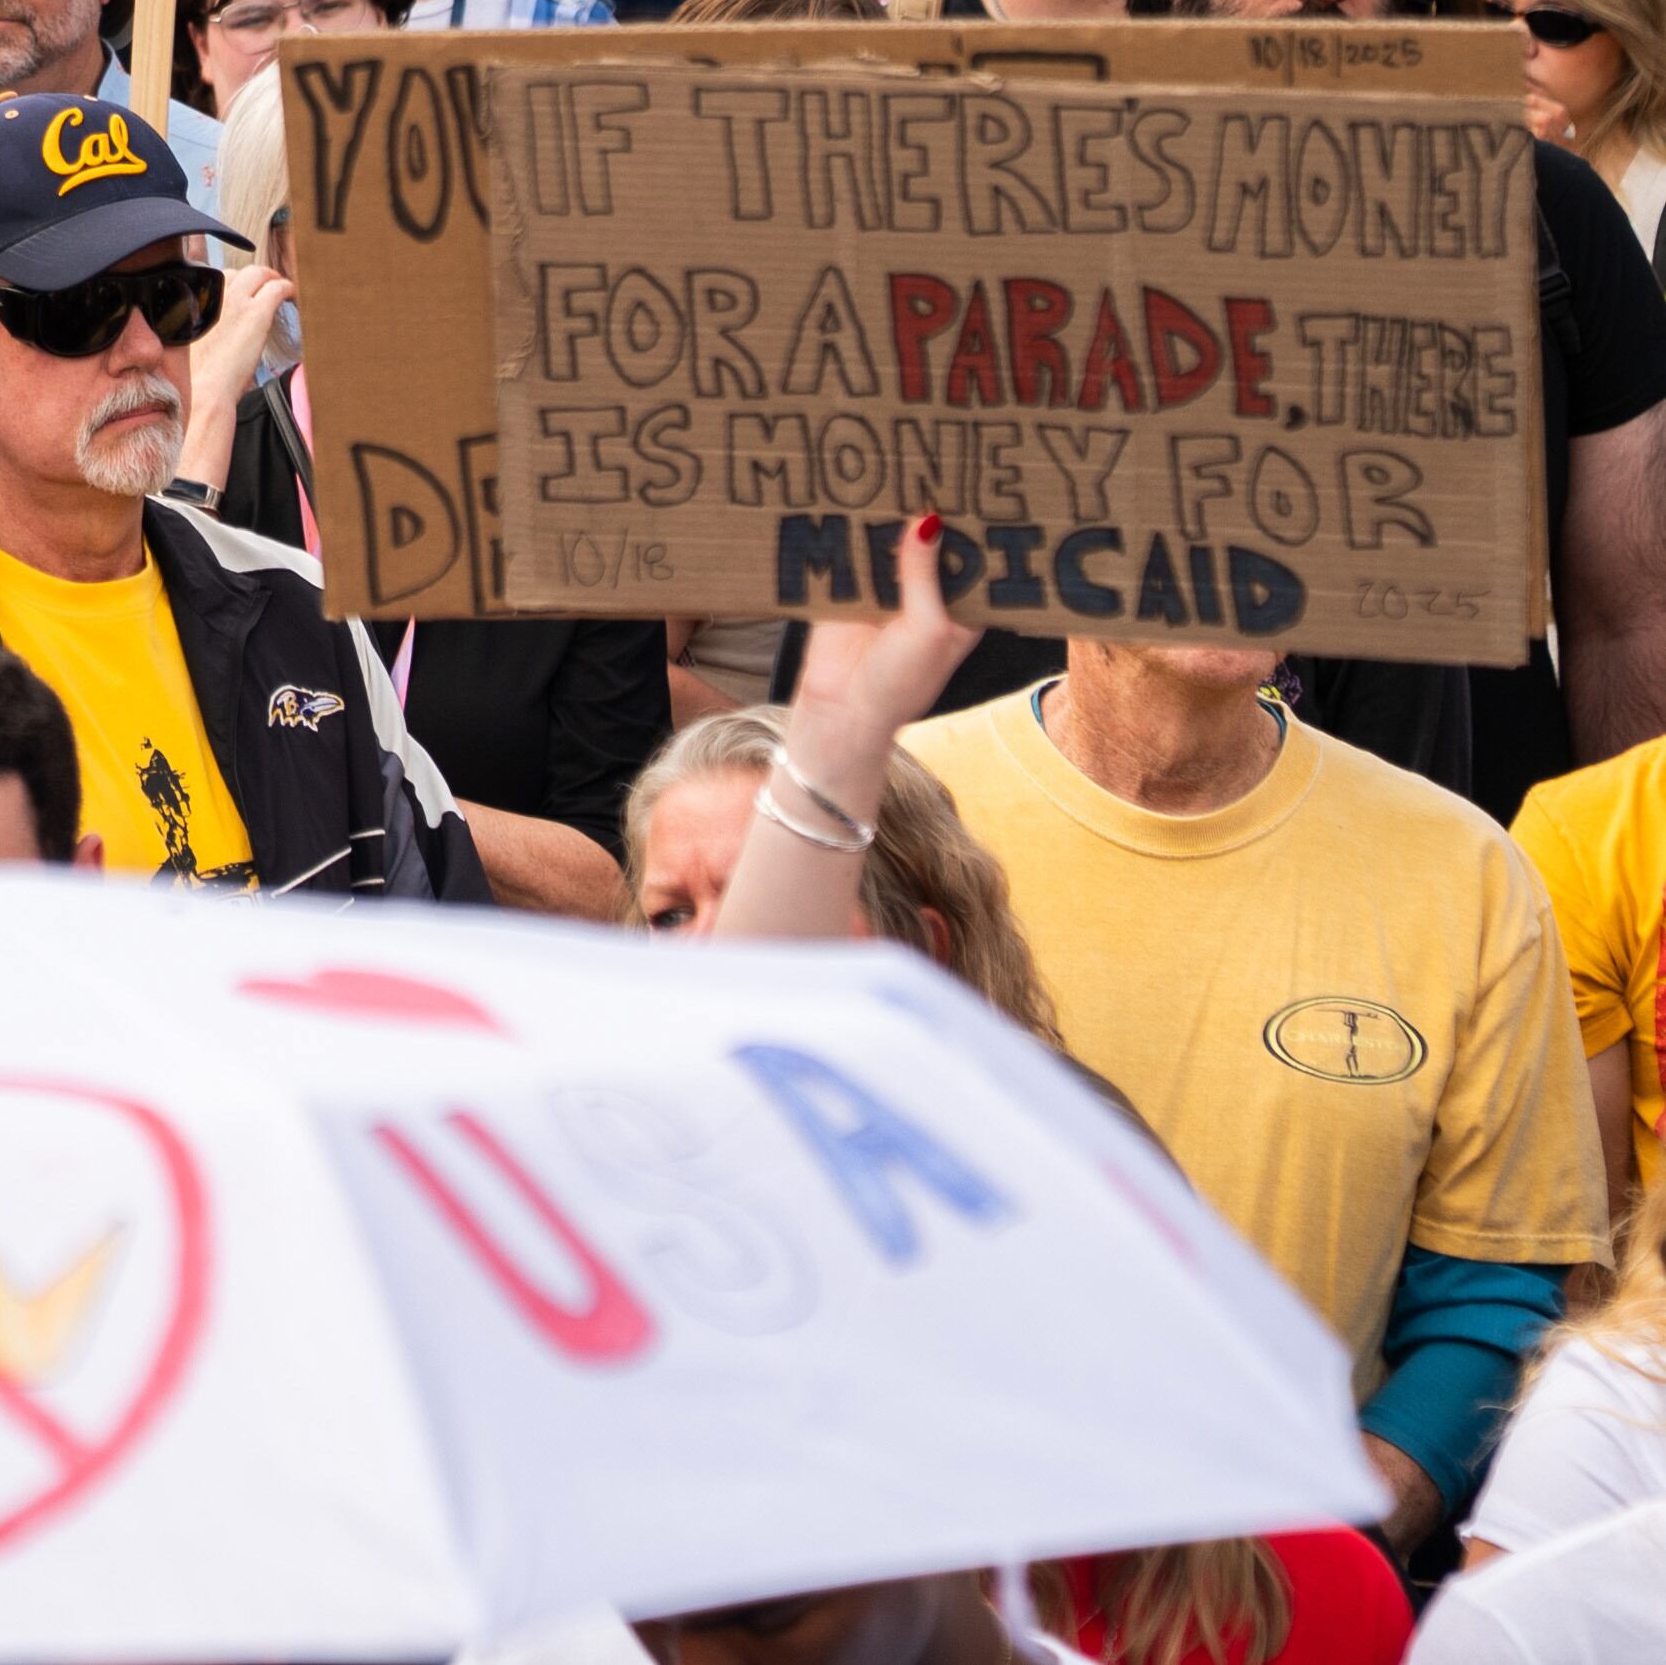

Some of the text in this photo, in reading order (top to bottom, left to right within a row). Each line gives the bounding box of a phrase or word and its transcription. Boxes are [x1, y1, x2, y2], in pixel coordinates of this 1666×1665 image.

[41, 106, 149, 198] Cal
[526, 80, 1535, 260] IF THERE'S MONEY
[537, 261, 1522, 442] FOR A PARADE, THERE
[538, 403, 1439, 550] IS MONEY FOR
[557, 511, 1493, 636] 10/18 MEDICAID 2025
[369, 1036, 1027, 1368] USA
